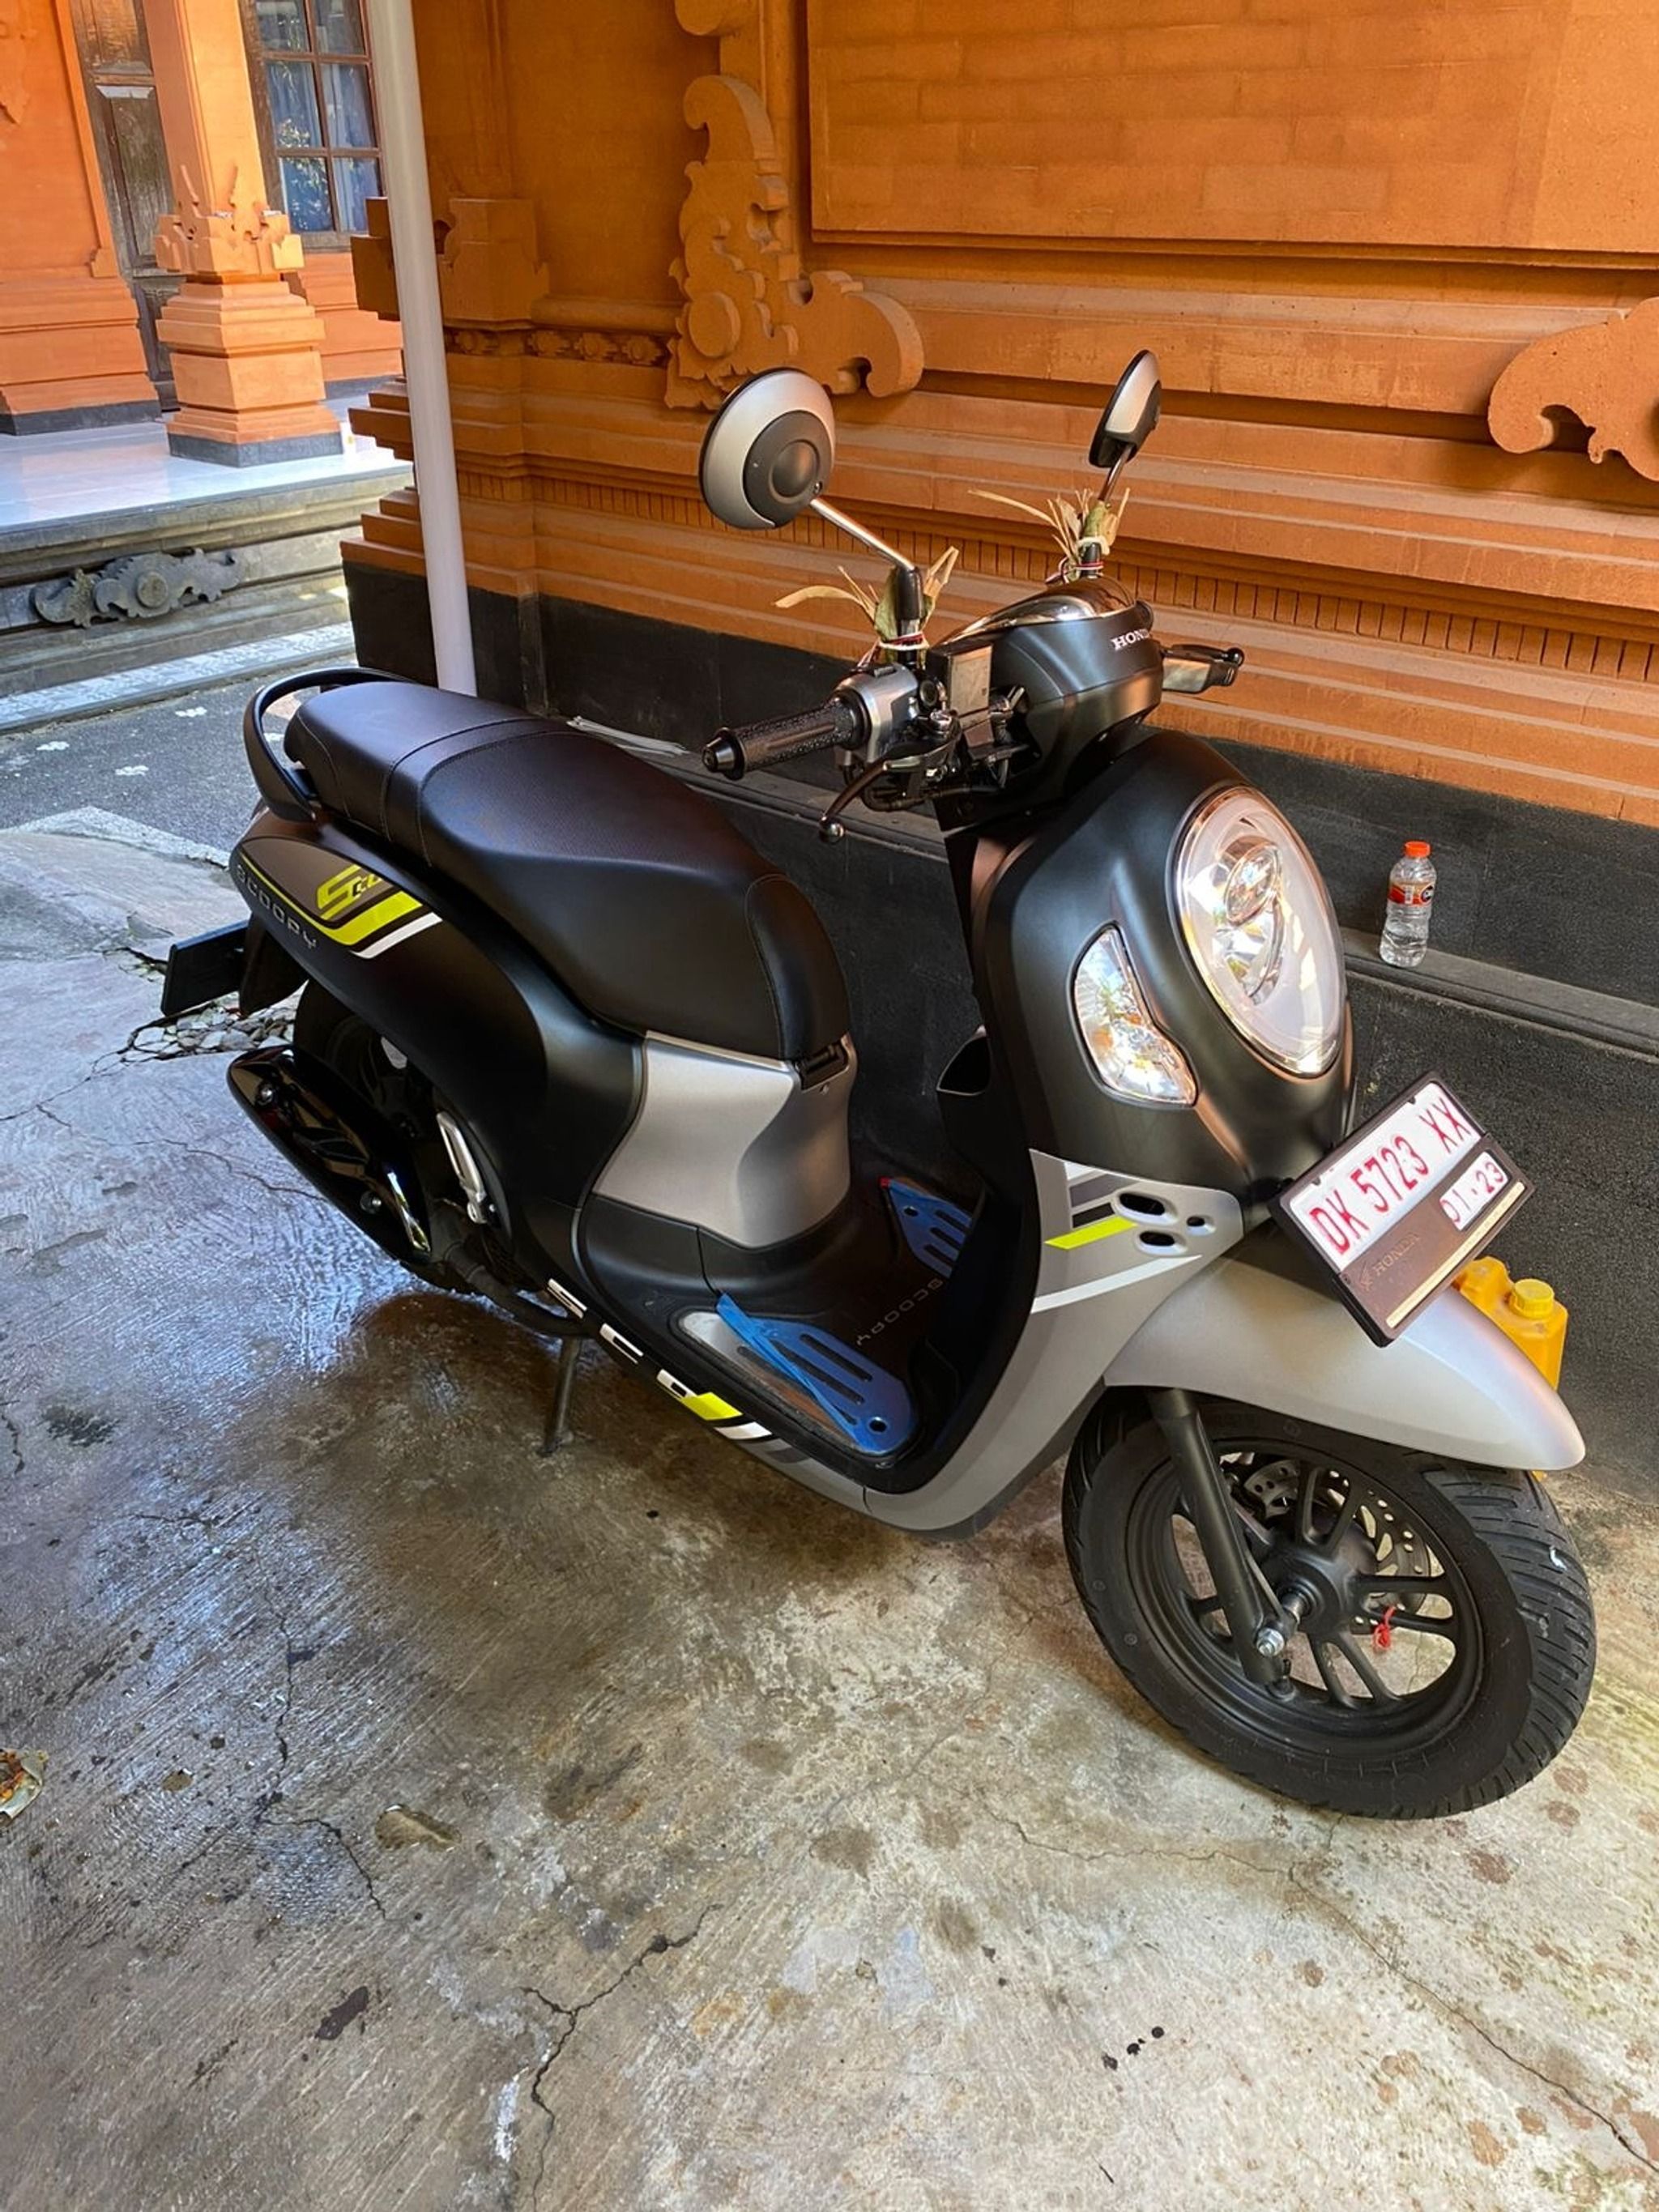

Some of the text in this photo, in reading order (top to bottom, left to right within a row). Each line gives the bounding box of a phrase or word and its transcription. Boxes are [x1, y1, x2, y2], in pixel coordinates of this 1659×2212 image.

[237, 864, 316, 949] SCOOPY
[1309, 1097, 1474, 1255] DK 5723 XX
[1372, 1231, 1420, 1276] HONDA
[856, 1277, 944, 1346] SCOOPY
